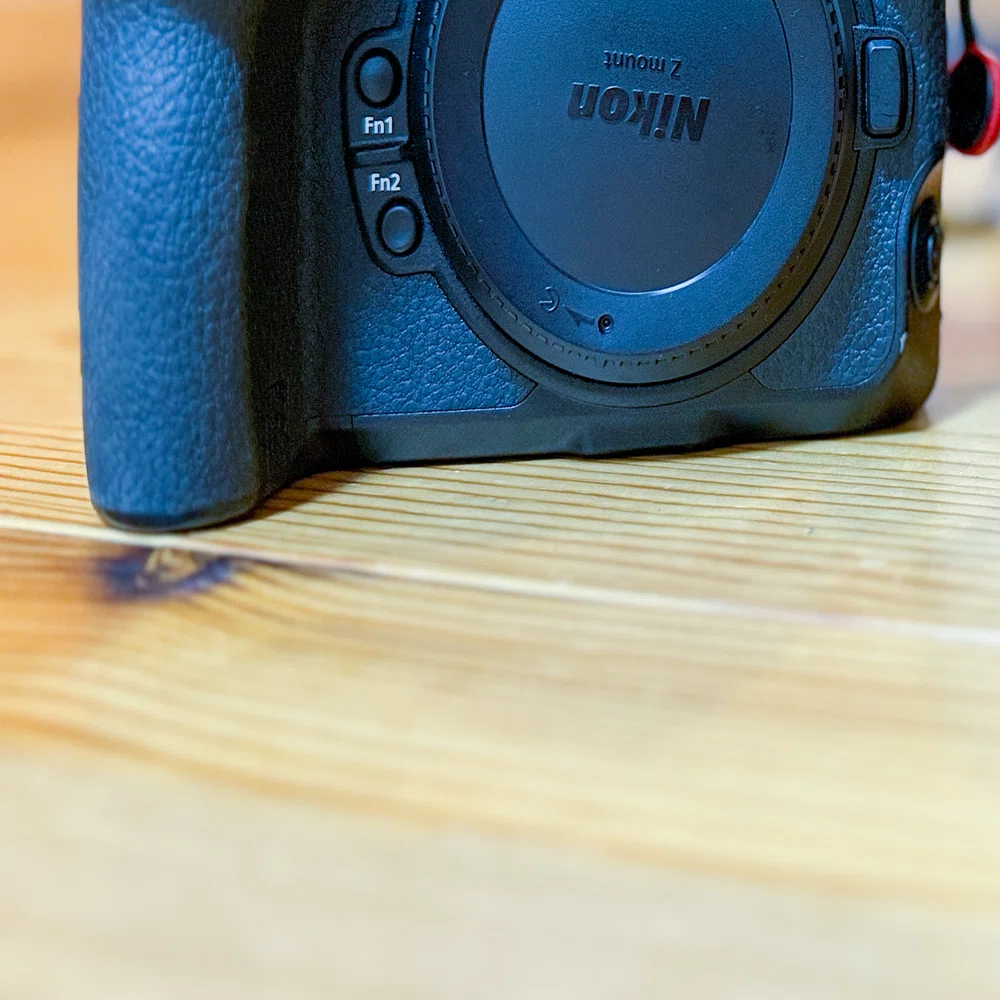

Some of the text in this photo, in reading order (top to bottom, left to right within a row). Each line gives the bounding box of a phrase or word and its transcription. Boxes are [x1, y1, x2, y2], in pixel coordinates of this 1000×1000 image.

[603, 50, 682, 78] Z mount
[567, 81, 711, 142] Nikon
[364, 116, 393, 134] Fn1
[371, 173, 401, 192] Fn2
